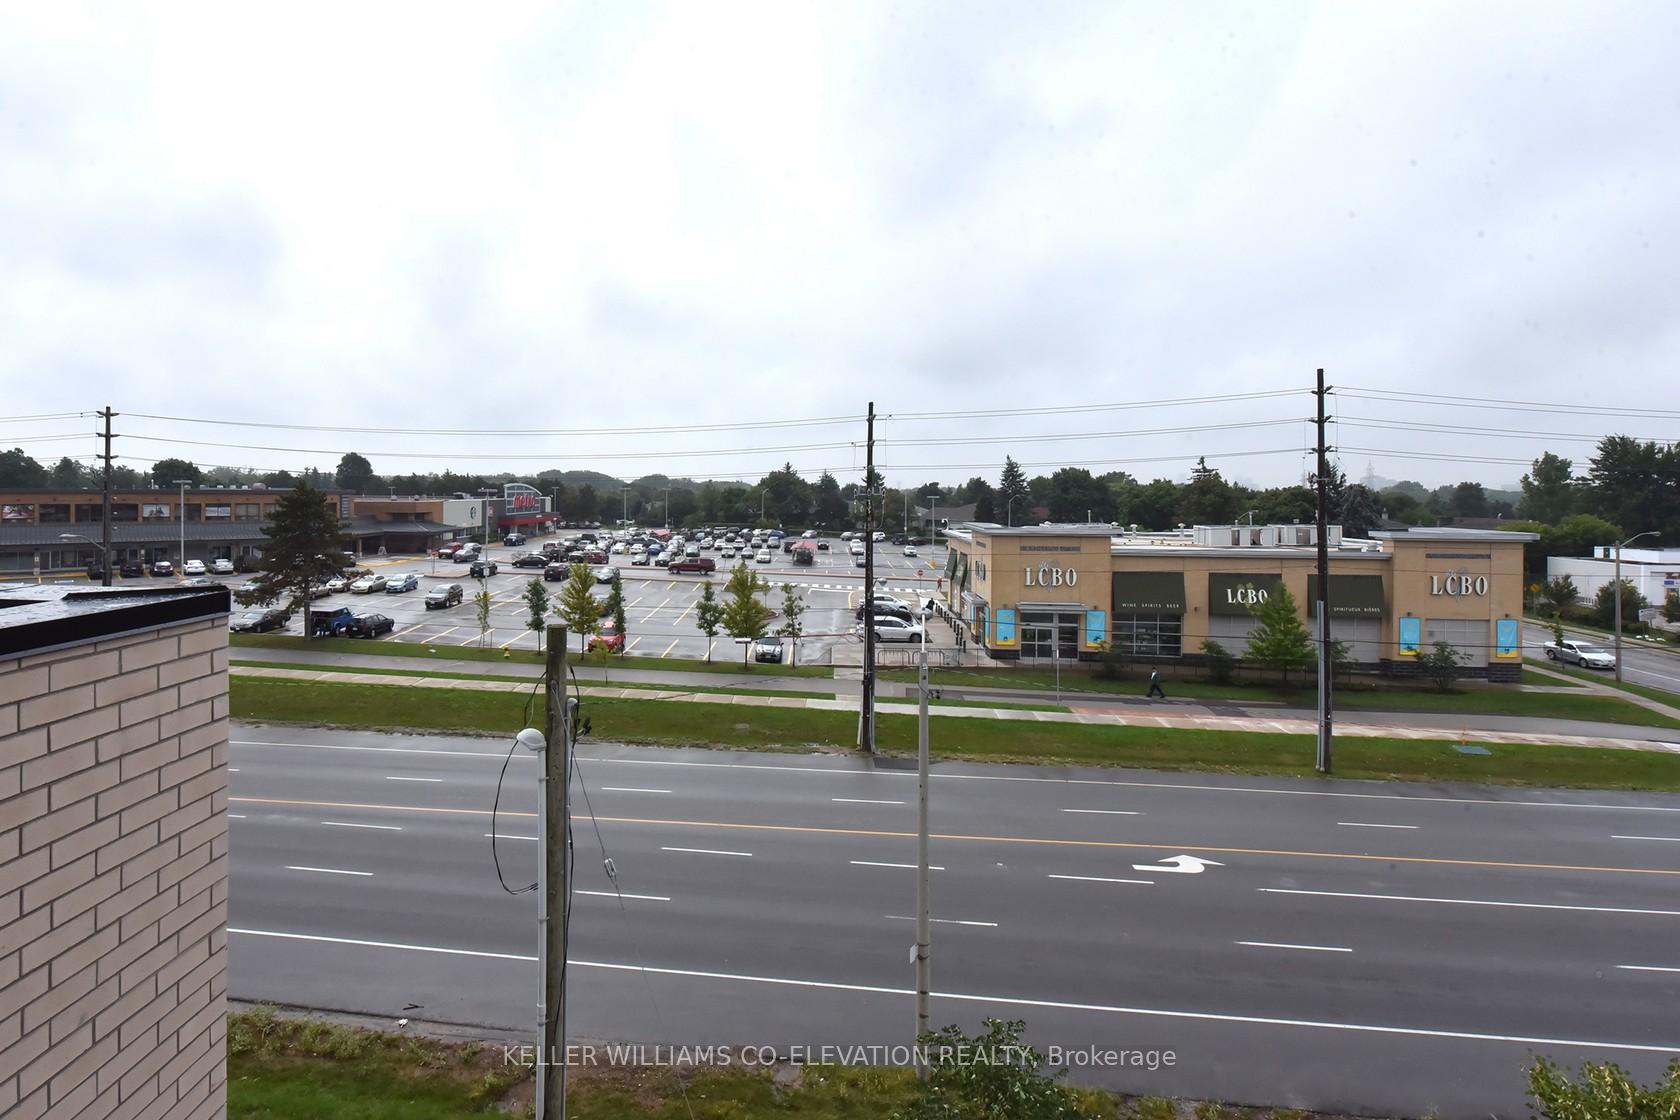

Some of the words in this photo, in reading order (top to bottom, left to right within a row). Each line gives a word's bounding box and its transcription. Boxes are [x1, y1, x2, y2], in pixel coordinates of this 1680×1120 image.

[1024, 567, 1078, 587] LCBO
[1431, 575, 1488, 596] LCBO
[1226, 588, 1268, 604] LCBO
